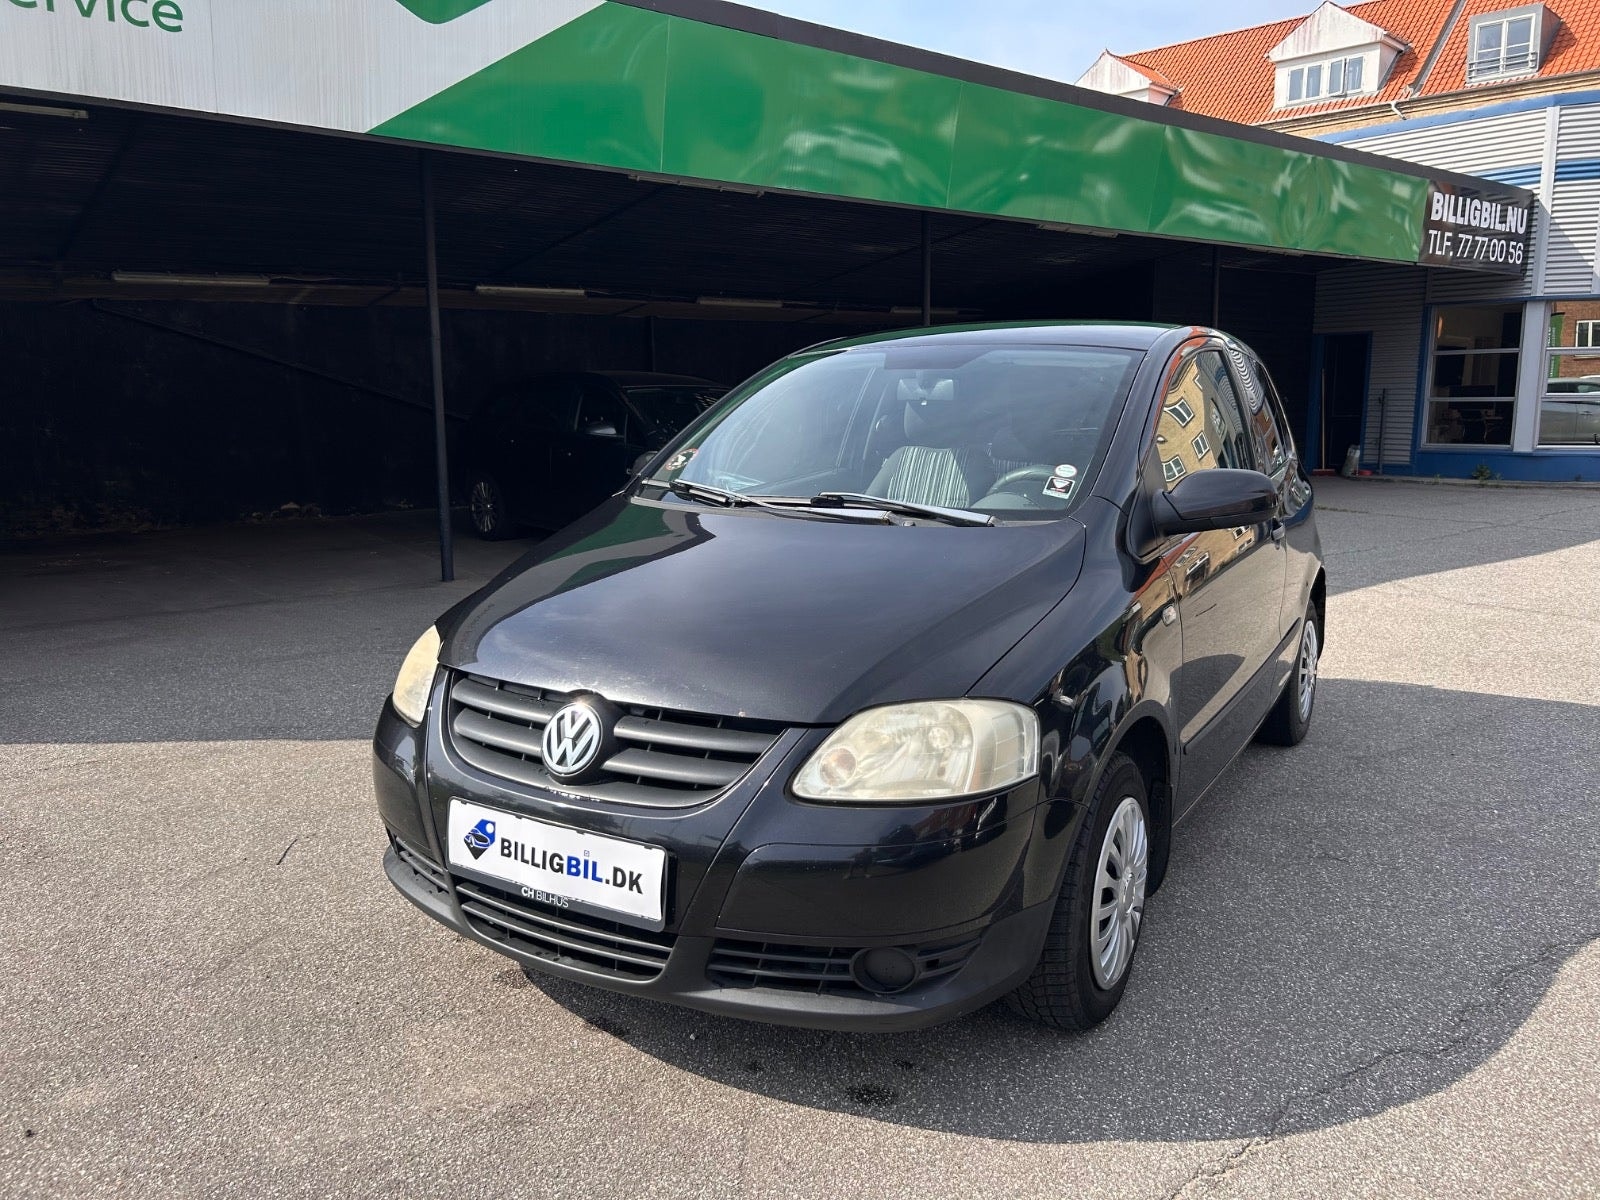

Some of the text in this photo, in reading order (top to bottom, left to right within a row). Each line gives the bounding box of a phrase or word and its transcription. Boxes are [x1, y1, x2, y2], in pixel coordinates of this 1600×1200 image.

[1430, 191, 1528, 234] BILLIGBIL.NU
[1428, 229, 1453, 256] TLF.
[1508, 241, 1524, 264] 56
[500, 837, 643, 894] BILLIGBIL.DK
[521, 886, 569, 908] CH BILHUS
